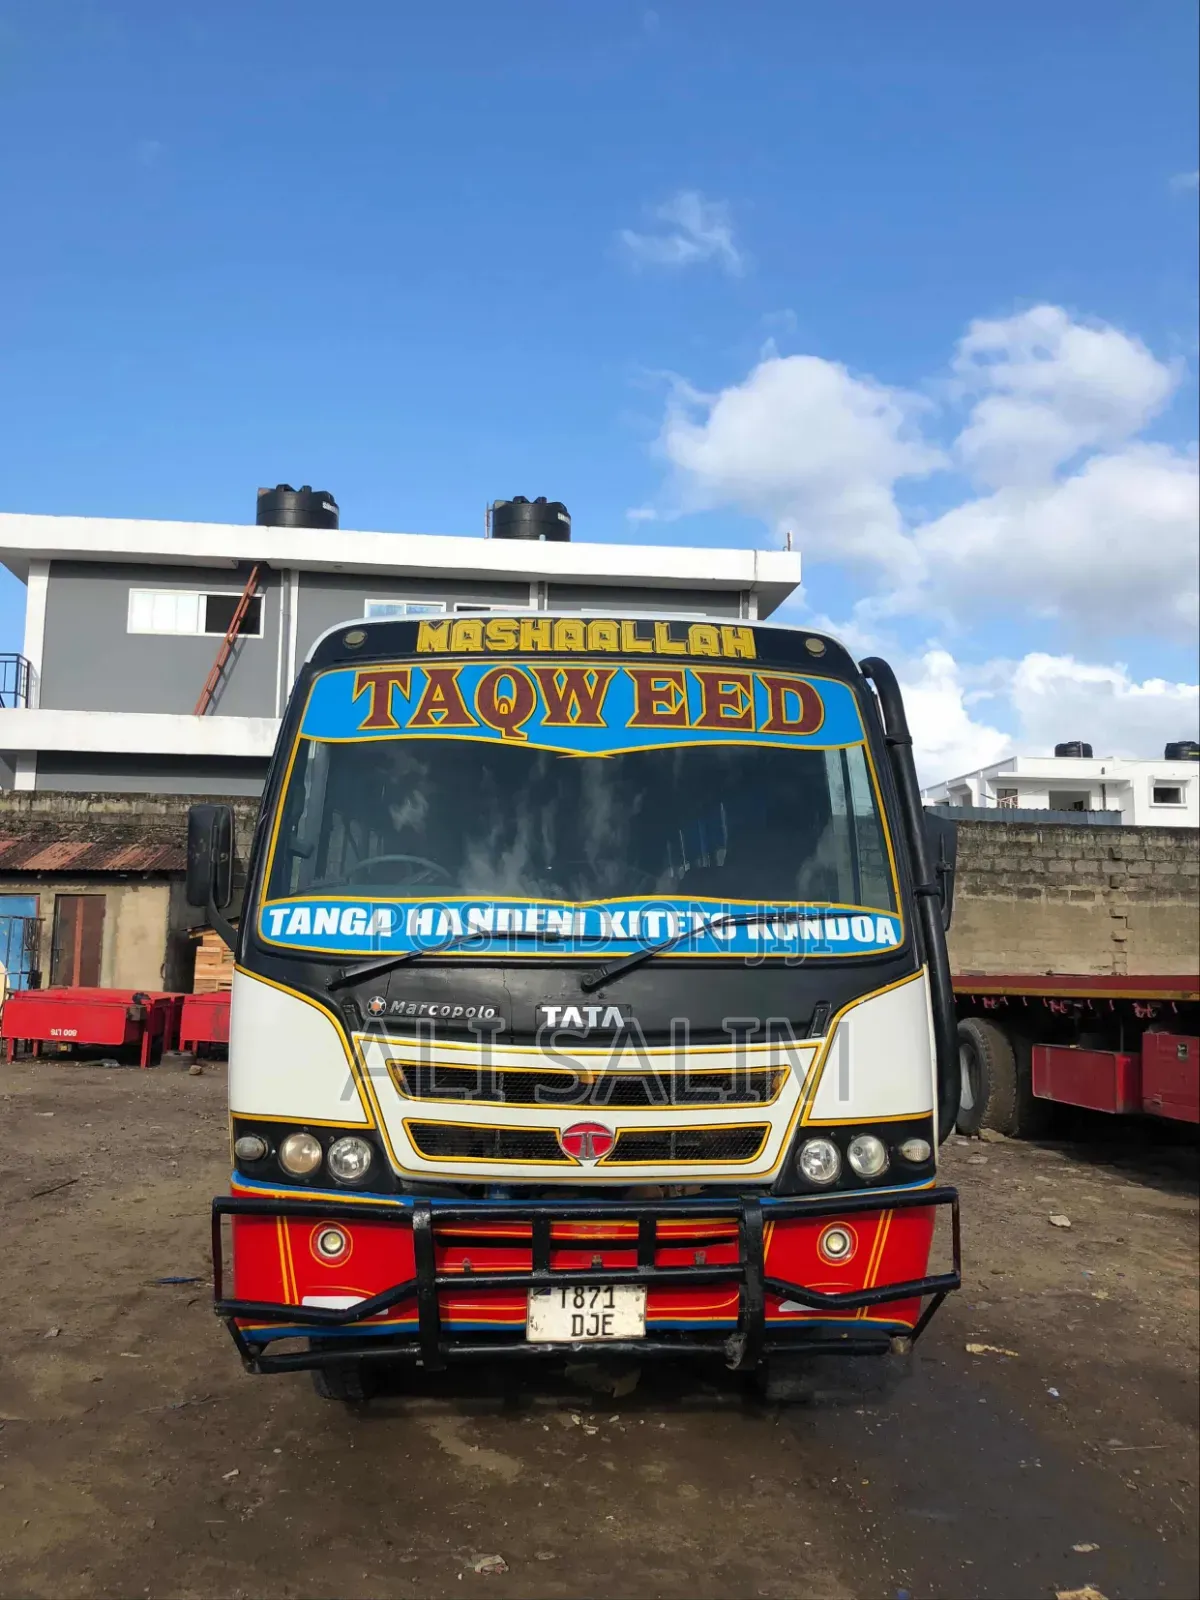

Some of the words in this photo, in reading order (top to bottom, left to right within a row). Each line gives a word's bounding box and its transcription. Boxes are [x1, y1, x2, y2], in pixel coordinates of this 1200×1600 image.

[416, 619, 756, 659] MASHAALLAH
[352, 666, 825, 741] TAQWEED
[269, 907, 391, 937] TANGA
[406, 908, 586, 937] HANDENI
[390, 1000, 495, 1019] Marcopolo
[541, 1006, 625, 1028] TATA
[557, 1286, 616, 1309] T871
[571, 1314, 614, 1337] DJE
